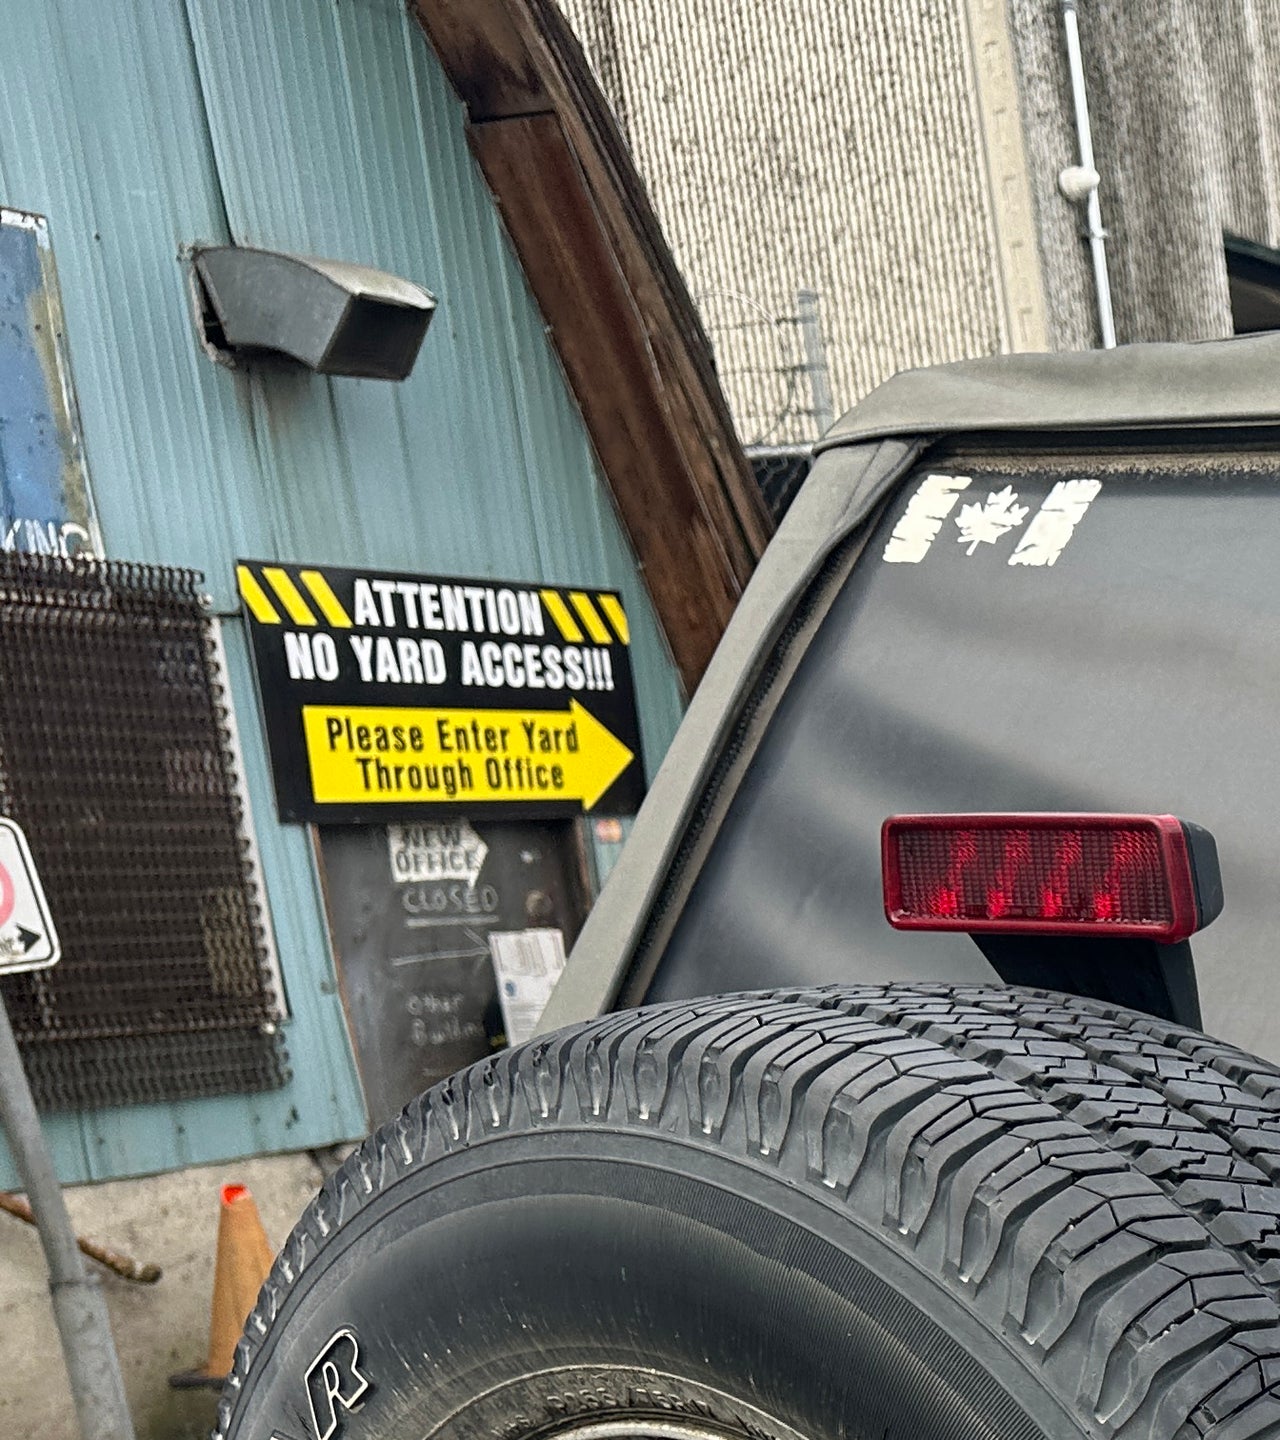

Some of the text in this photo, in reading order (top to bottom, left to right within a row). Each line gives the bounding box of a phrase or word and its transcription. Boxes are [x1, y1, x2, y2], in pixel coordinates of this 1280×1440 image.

[354, 577, 546, 638] ATTENTION
[283, 631, 615, 692] NO YARD ACCESS!!!
[326, 716, 580, 752] Please Enter Yard
[355, 757, 565, 796] Through Office
[401, 825, 461, 848] NEW
[396, 848, 479, 874] OFFICE
[402, 884, 500, 913] CLOSED
